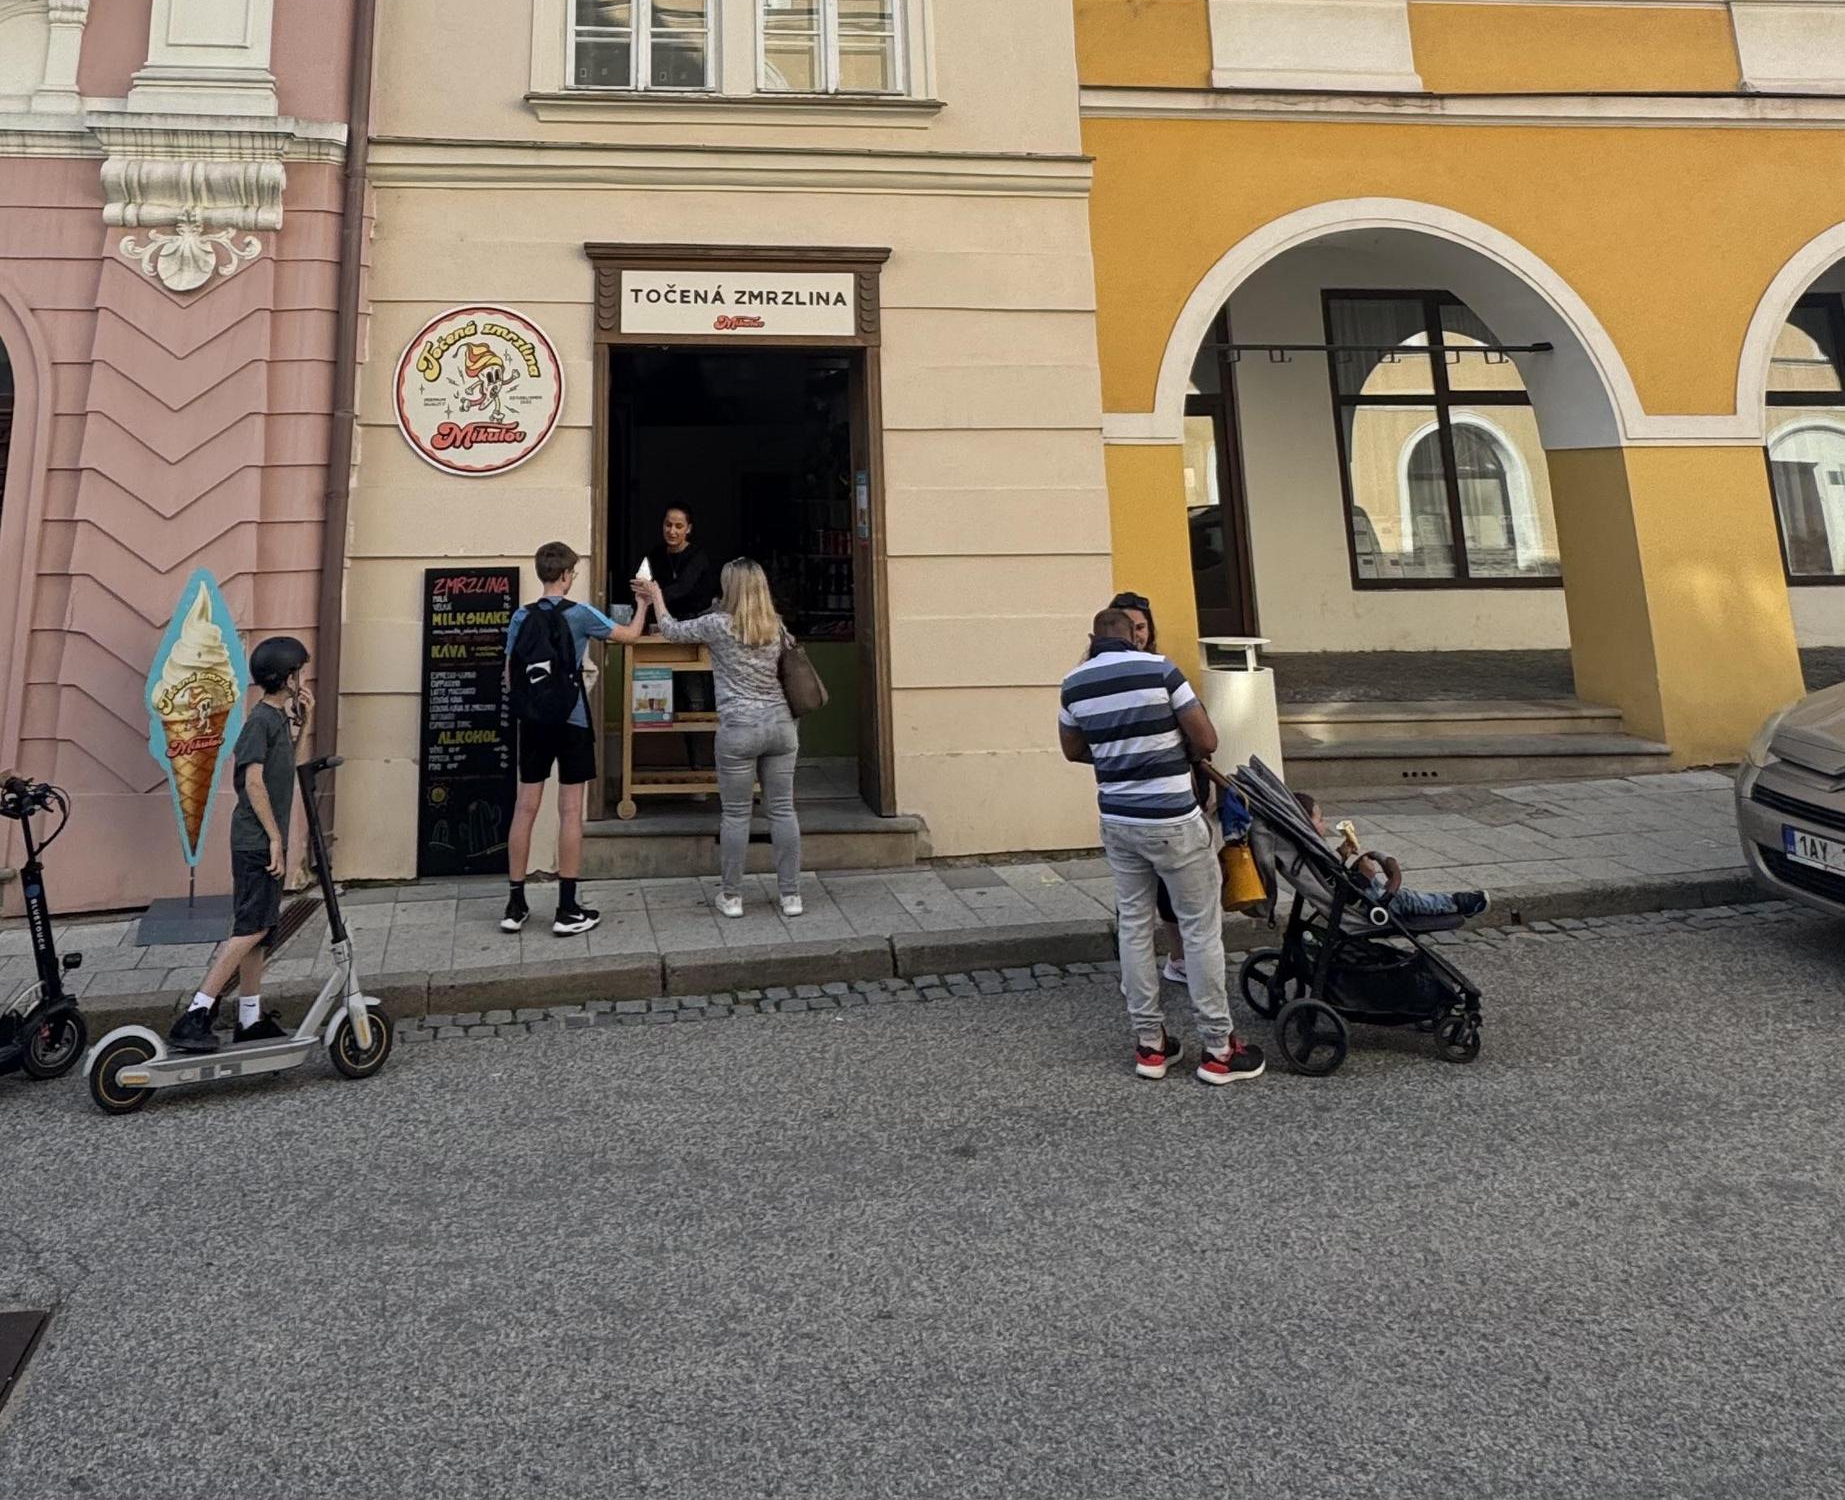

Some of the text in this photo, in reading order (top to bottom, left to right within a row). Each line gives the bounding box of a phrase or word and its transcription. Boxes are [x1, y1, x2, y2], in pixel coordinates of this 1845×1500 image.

[630, 283, 847, 307] TOČENÁ ZMRZLINA
[417, 320, 541, 382] Točená zmrzlina
[430, 421, 527, 450] Mikulov
[432, 577, 509, 596] ZMRZLINA
[432, 611, 510, 626] MILKSHAKE
[437, 730, 498, 745] ALKOHOL
